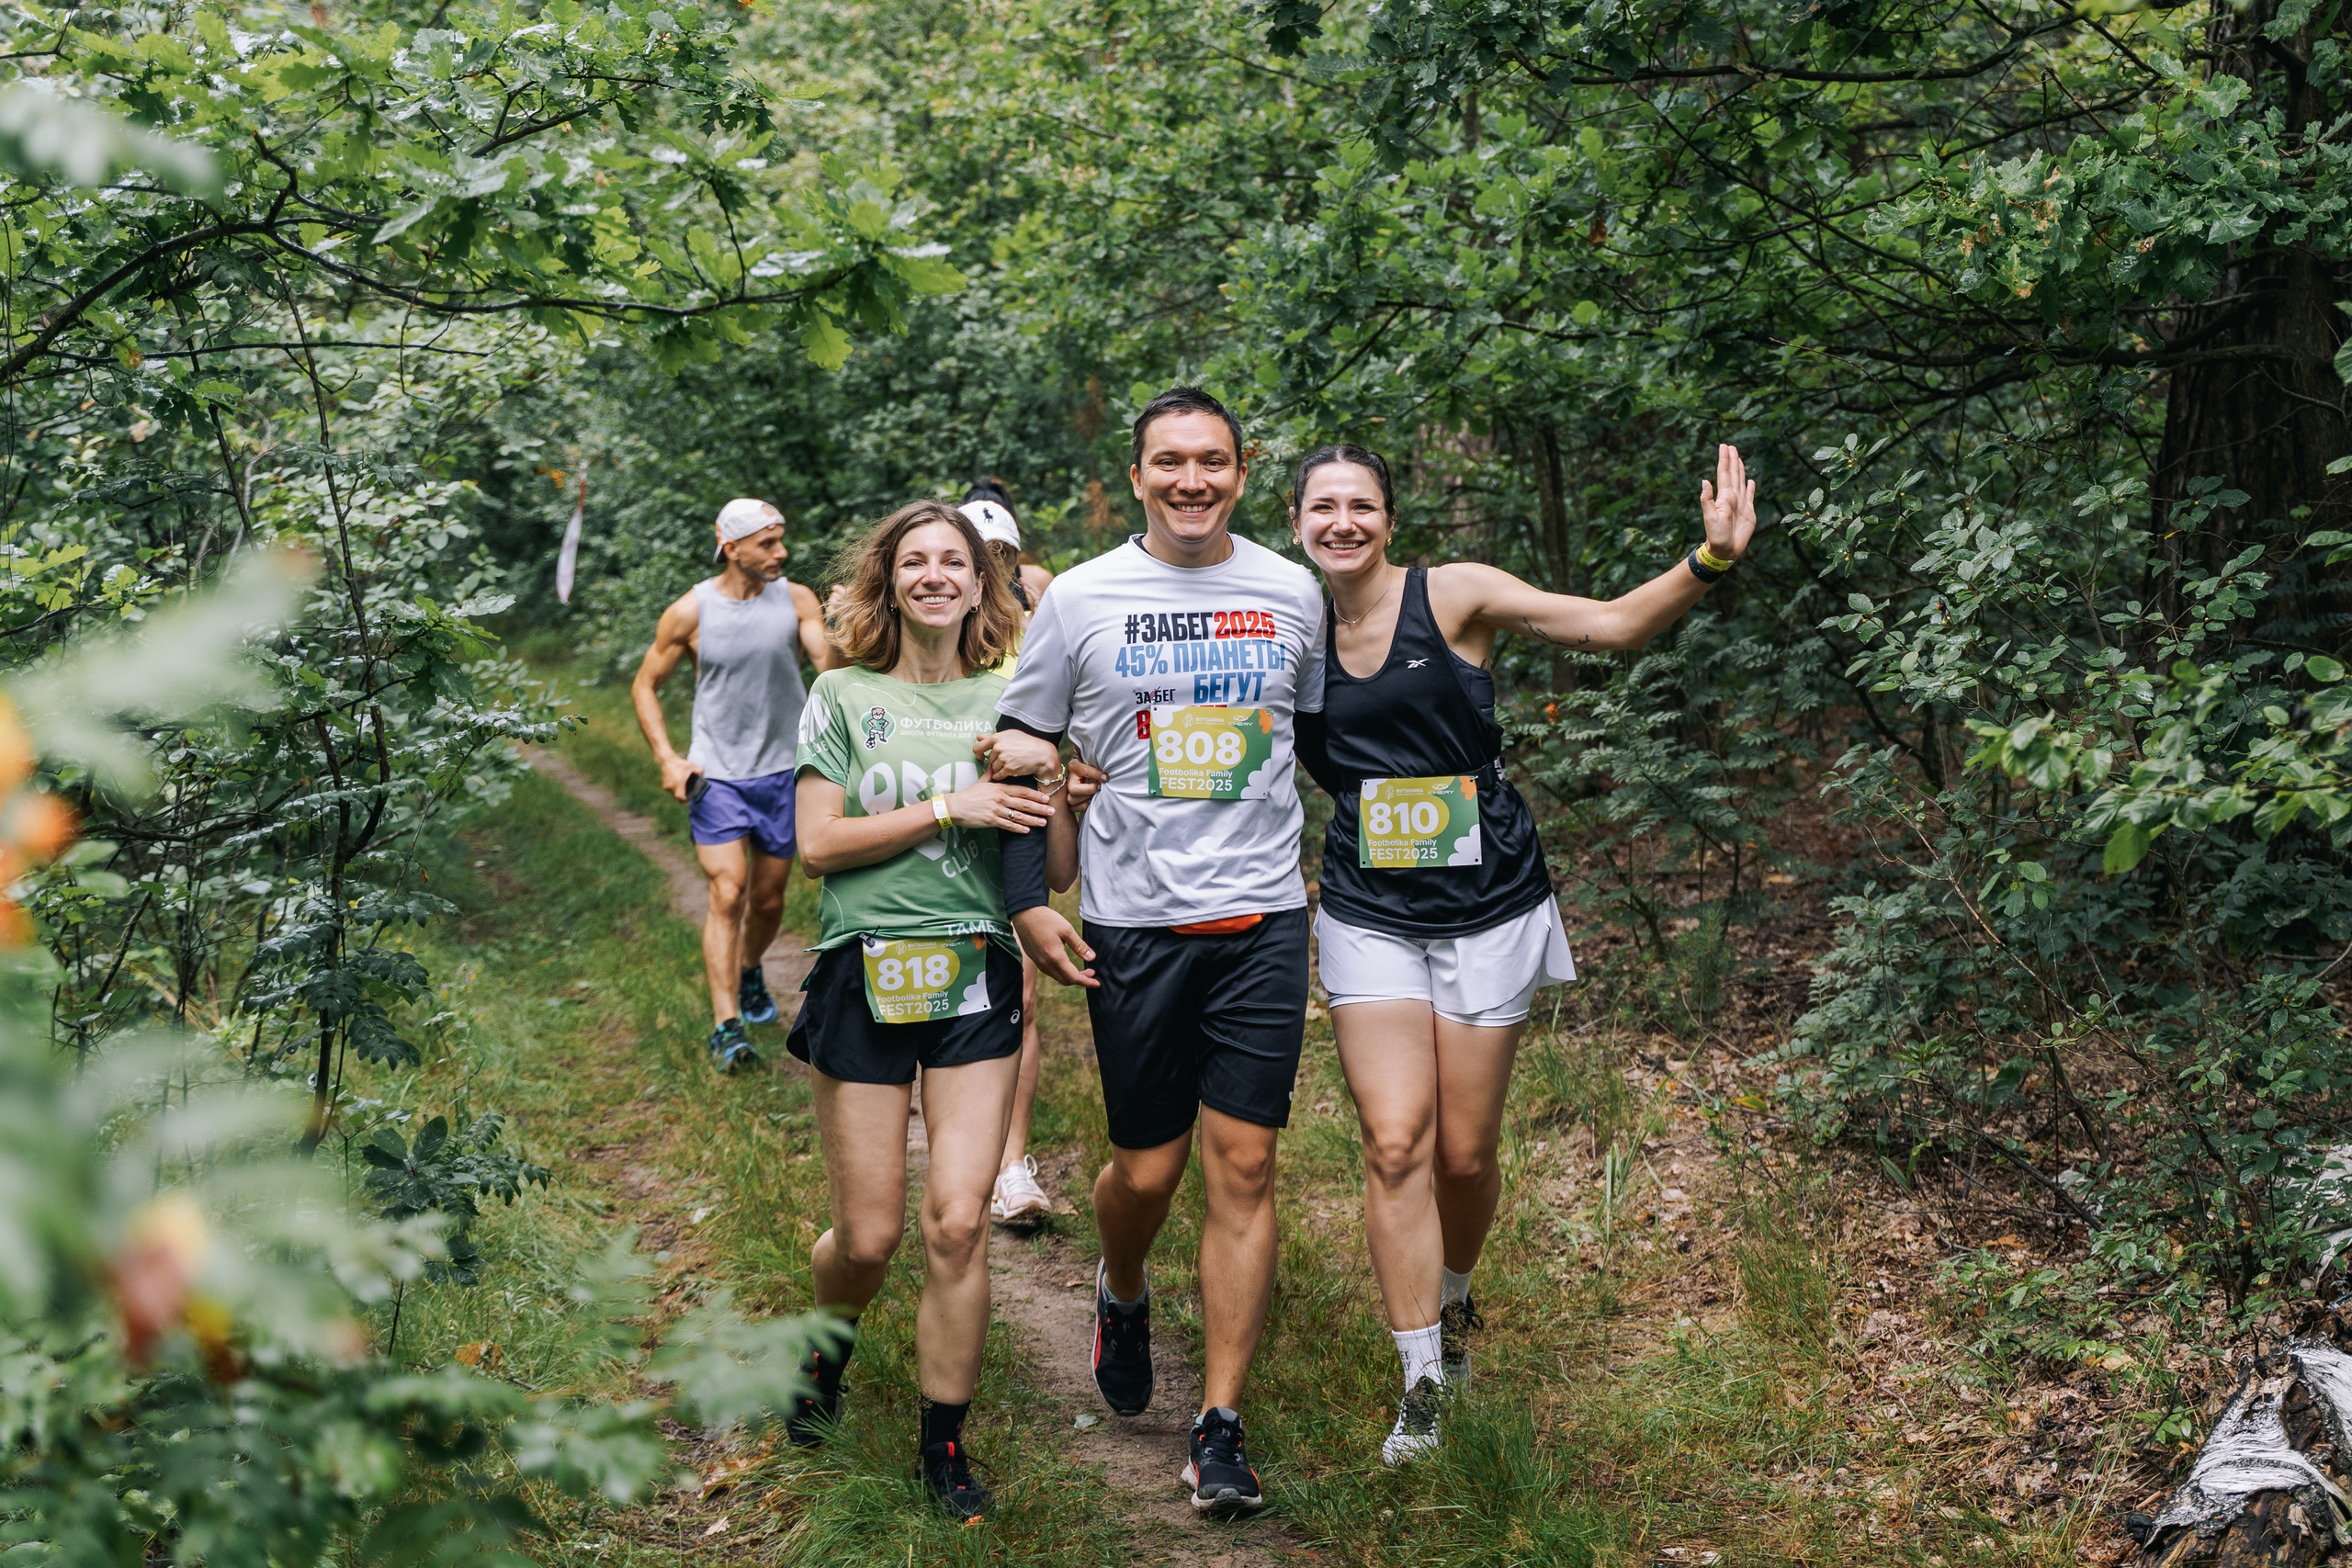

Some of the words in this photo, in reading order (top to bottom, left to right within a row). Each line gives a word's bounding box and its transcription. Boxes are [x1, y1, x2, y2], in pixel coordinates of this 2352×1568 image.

[1114, 644, 1169, 678] 45%
[1172, 639, 1285, 673] ПЛАНЕТЫ
[1193, 671, 1266, 704] БЕГУТ
[900, 716, 993, 732] ФУТБОЛИКА
[1156, 729, 1241, 766] 808
[1159, 767, 1204, 777] Footbolika
[1205, 770, 1233, 779] Family
[1159, 776, 1233, 792] FEST2025
[1369, 801, 1440, 835] 810
[1367, 838, 1408, 847] Footbolika
[1410, 838, 1437, 847] Family
[942, 839, 979, 878] CLUB
[1369, 848, 1439, 860] FEST2025
[877, 953, 951, 991] 818
[876, 993, 922, 1003] Footbolika
[922, 990, 949, 1000] Family
[878, 998, 950, 1017] FEST2025
